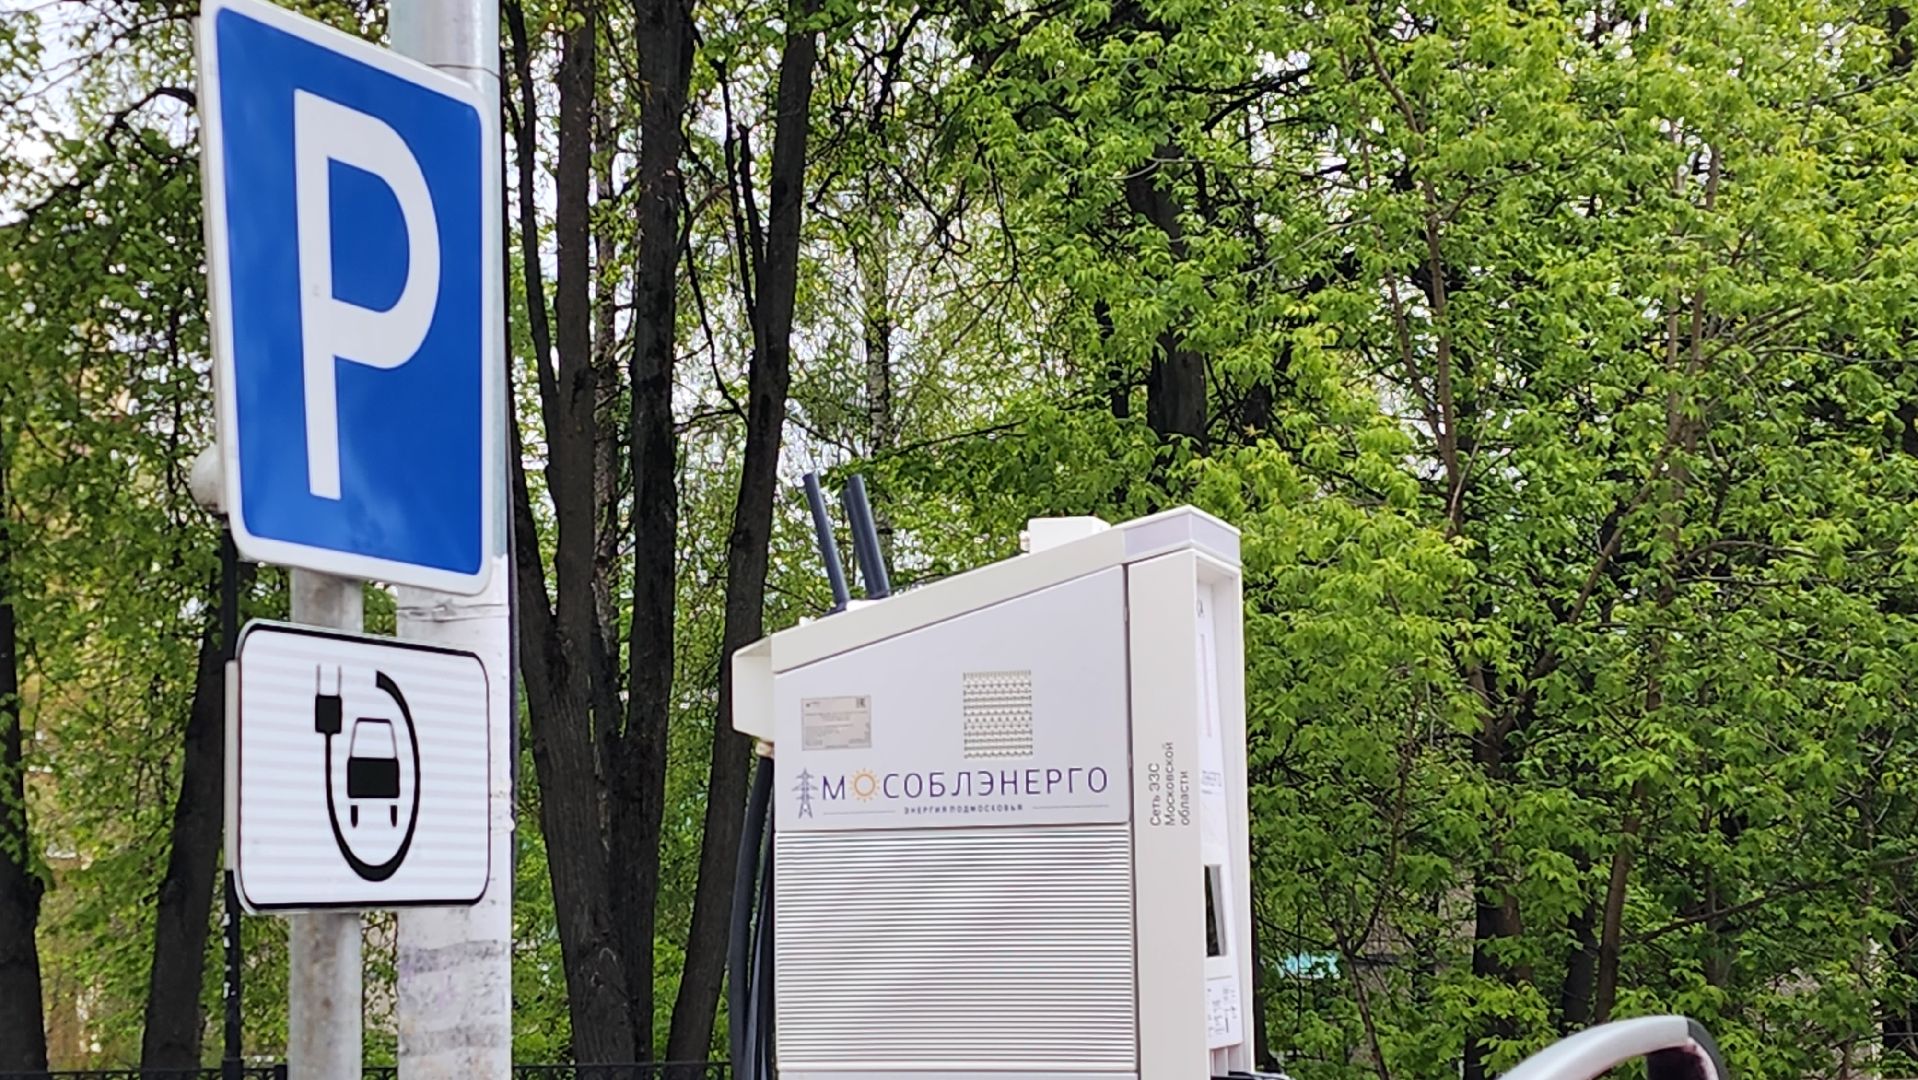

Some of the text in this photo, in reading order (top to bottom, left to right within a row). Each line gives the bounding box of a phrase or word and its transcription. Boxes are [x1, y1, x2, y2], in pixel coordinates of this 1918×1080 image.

[294, 89, 441, 500] P
[822, 766, 1108, 801] МОСОБЛЭНЕРГО
[904, 803, 1023, 815] ЭНЕРГИЯ ПОДМОСКОВЬЯ
[1148, 763, 1162, 826] Сеть ЭЗС
[1162, 742, 1176, 826] Московской
[1177, 771, 1190, 826] области
